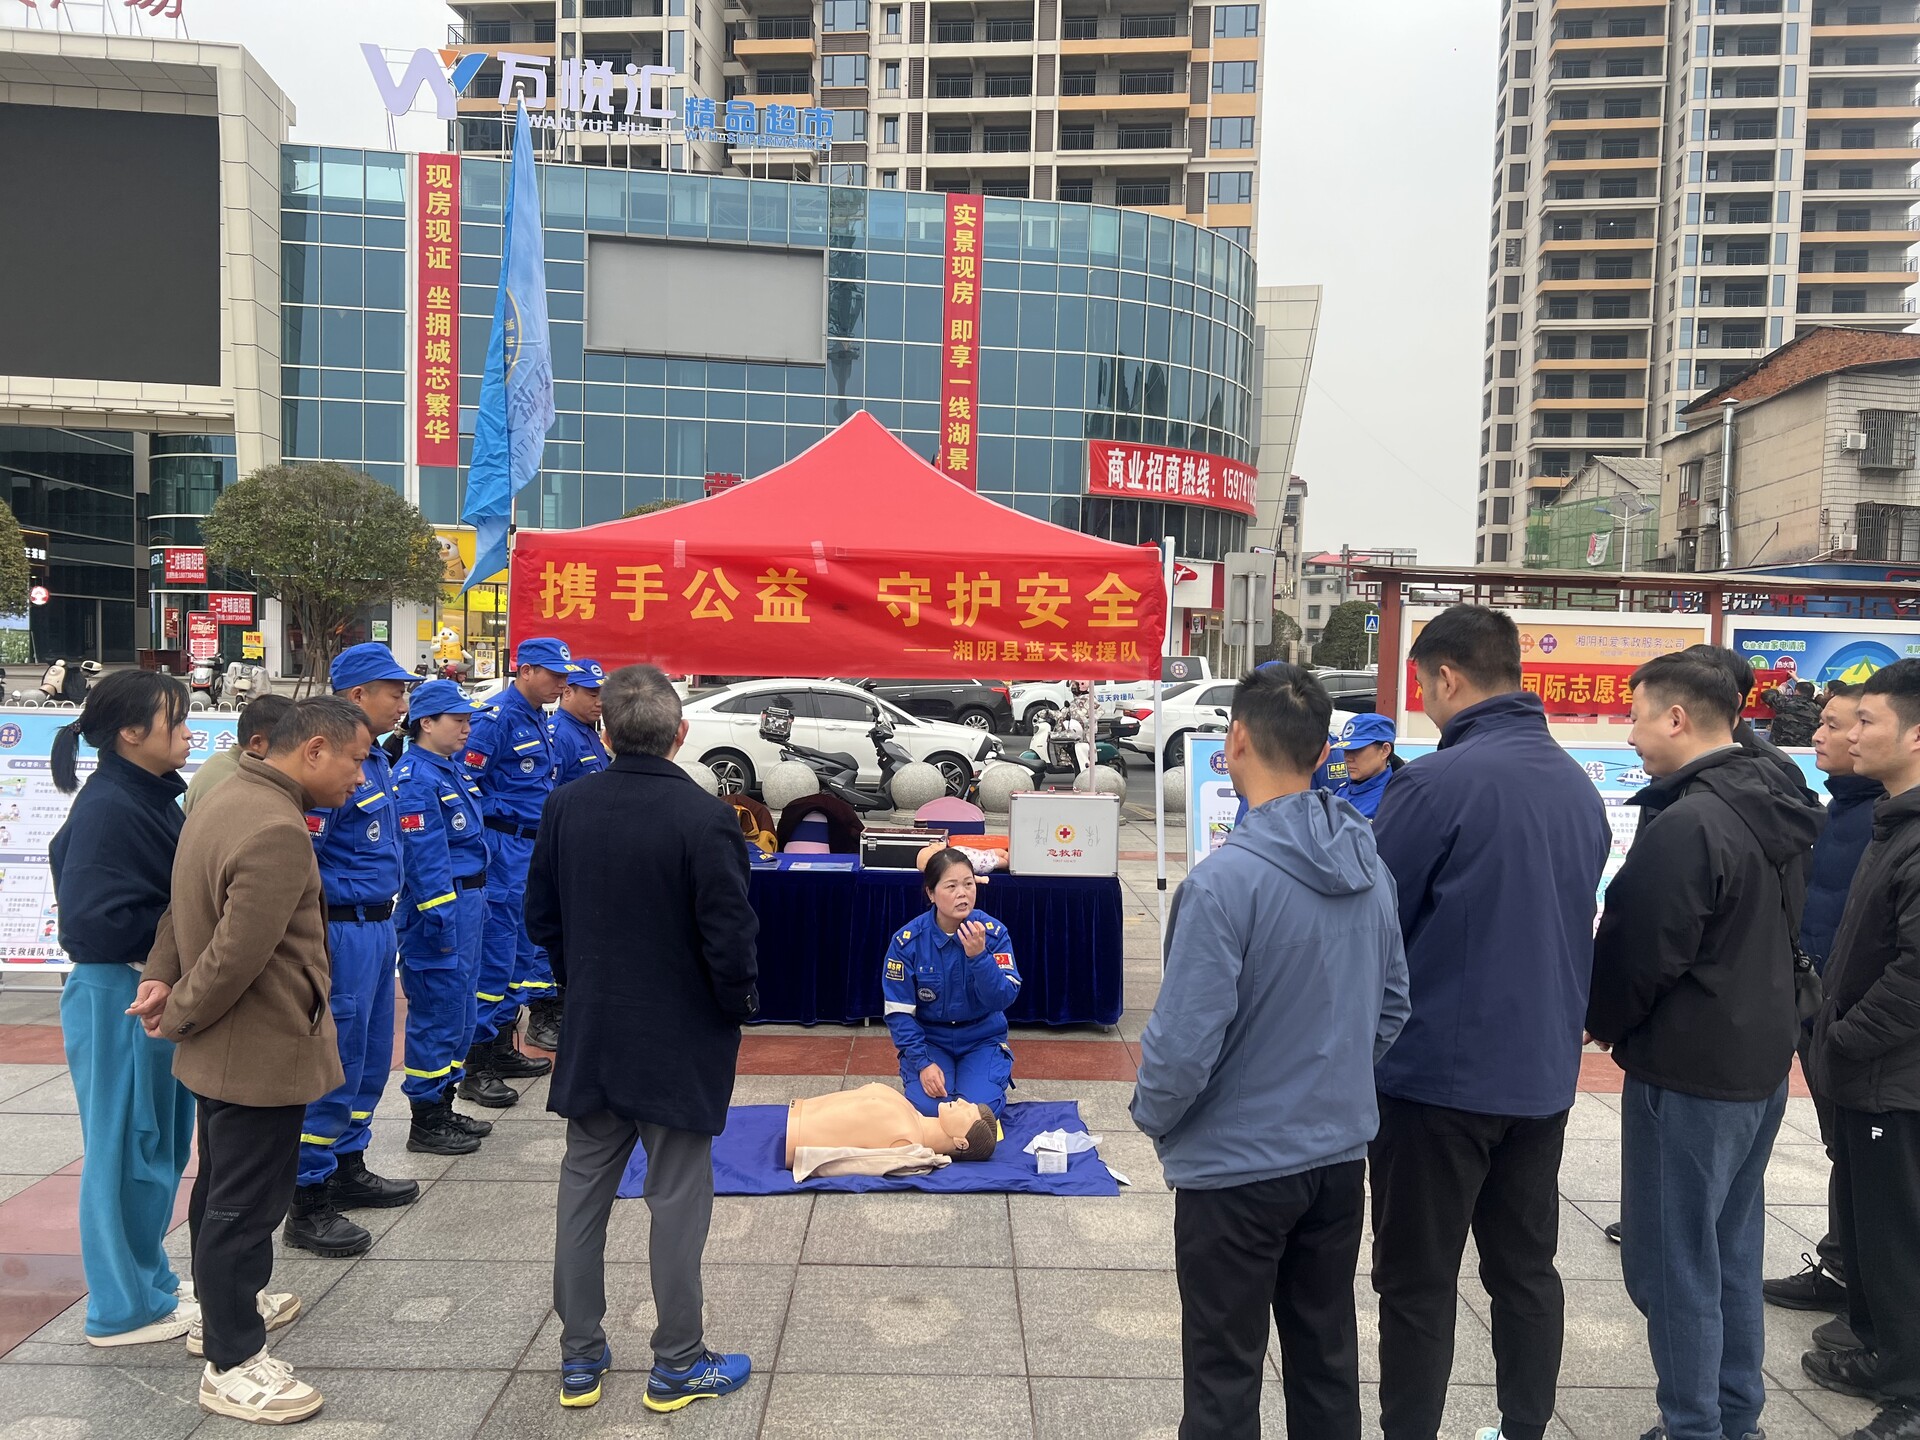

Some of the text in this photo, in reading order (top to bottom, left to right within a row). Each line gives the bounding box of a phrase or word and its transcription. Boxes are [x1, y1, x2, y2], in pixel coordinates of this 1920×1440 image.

[497, 52, 677, 119] 万悦汇
[578, 119, 613, 134] YUE
[685, 97, 834, 138] 精品超市
[424, 164, 453, 444] 现房现证 坐拥城芯繁华
[947, 203, 977, 471] 实景现房 即享一线湖景
[539, 561, 1142, 629] 携手公益 守护安全
[1575, 635, 1685, 650] 湘阴和爱家政服务公司
[190, 731, 236, 750] 安全
[1586, 762, 1604, 781] 线
[1047, 849, 1083, 857] 急救箱
[887, 961, 901, 971] BSR
